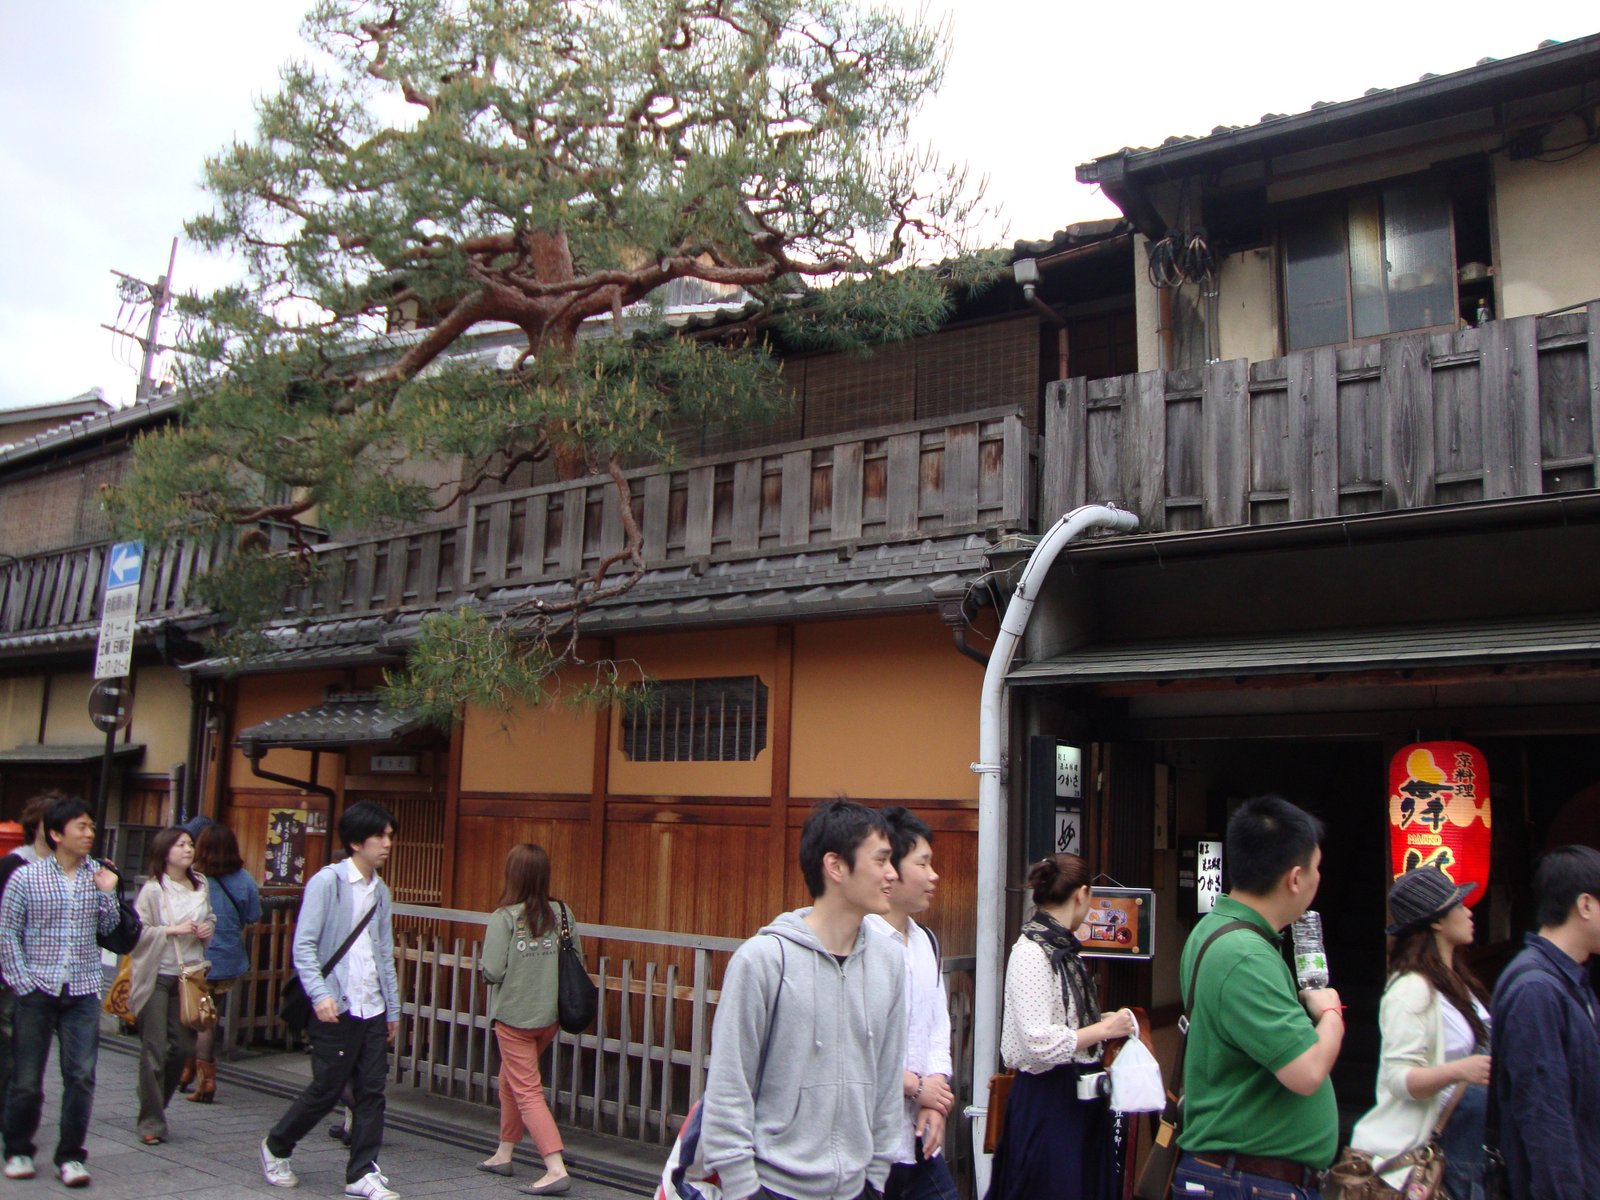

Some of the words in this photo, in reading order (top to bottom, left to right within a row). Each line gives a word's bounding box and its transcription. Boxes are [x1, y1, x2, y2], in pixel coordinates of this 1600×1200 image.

[1058, 774, 1080, 788] つかさ
[1455, 752, 1475, 798] 京料理
[1198, 874, 1222, 893] つかさ
